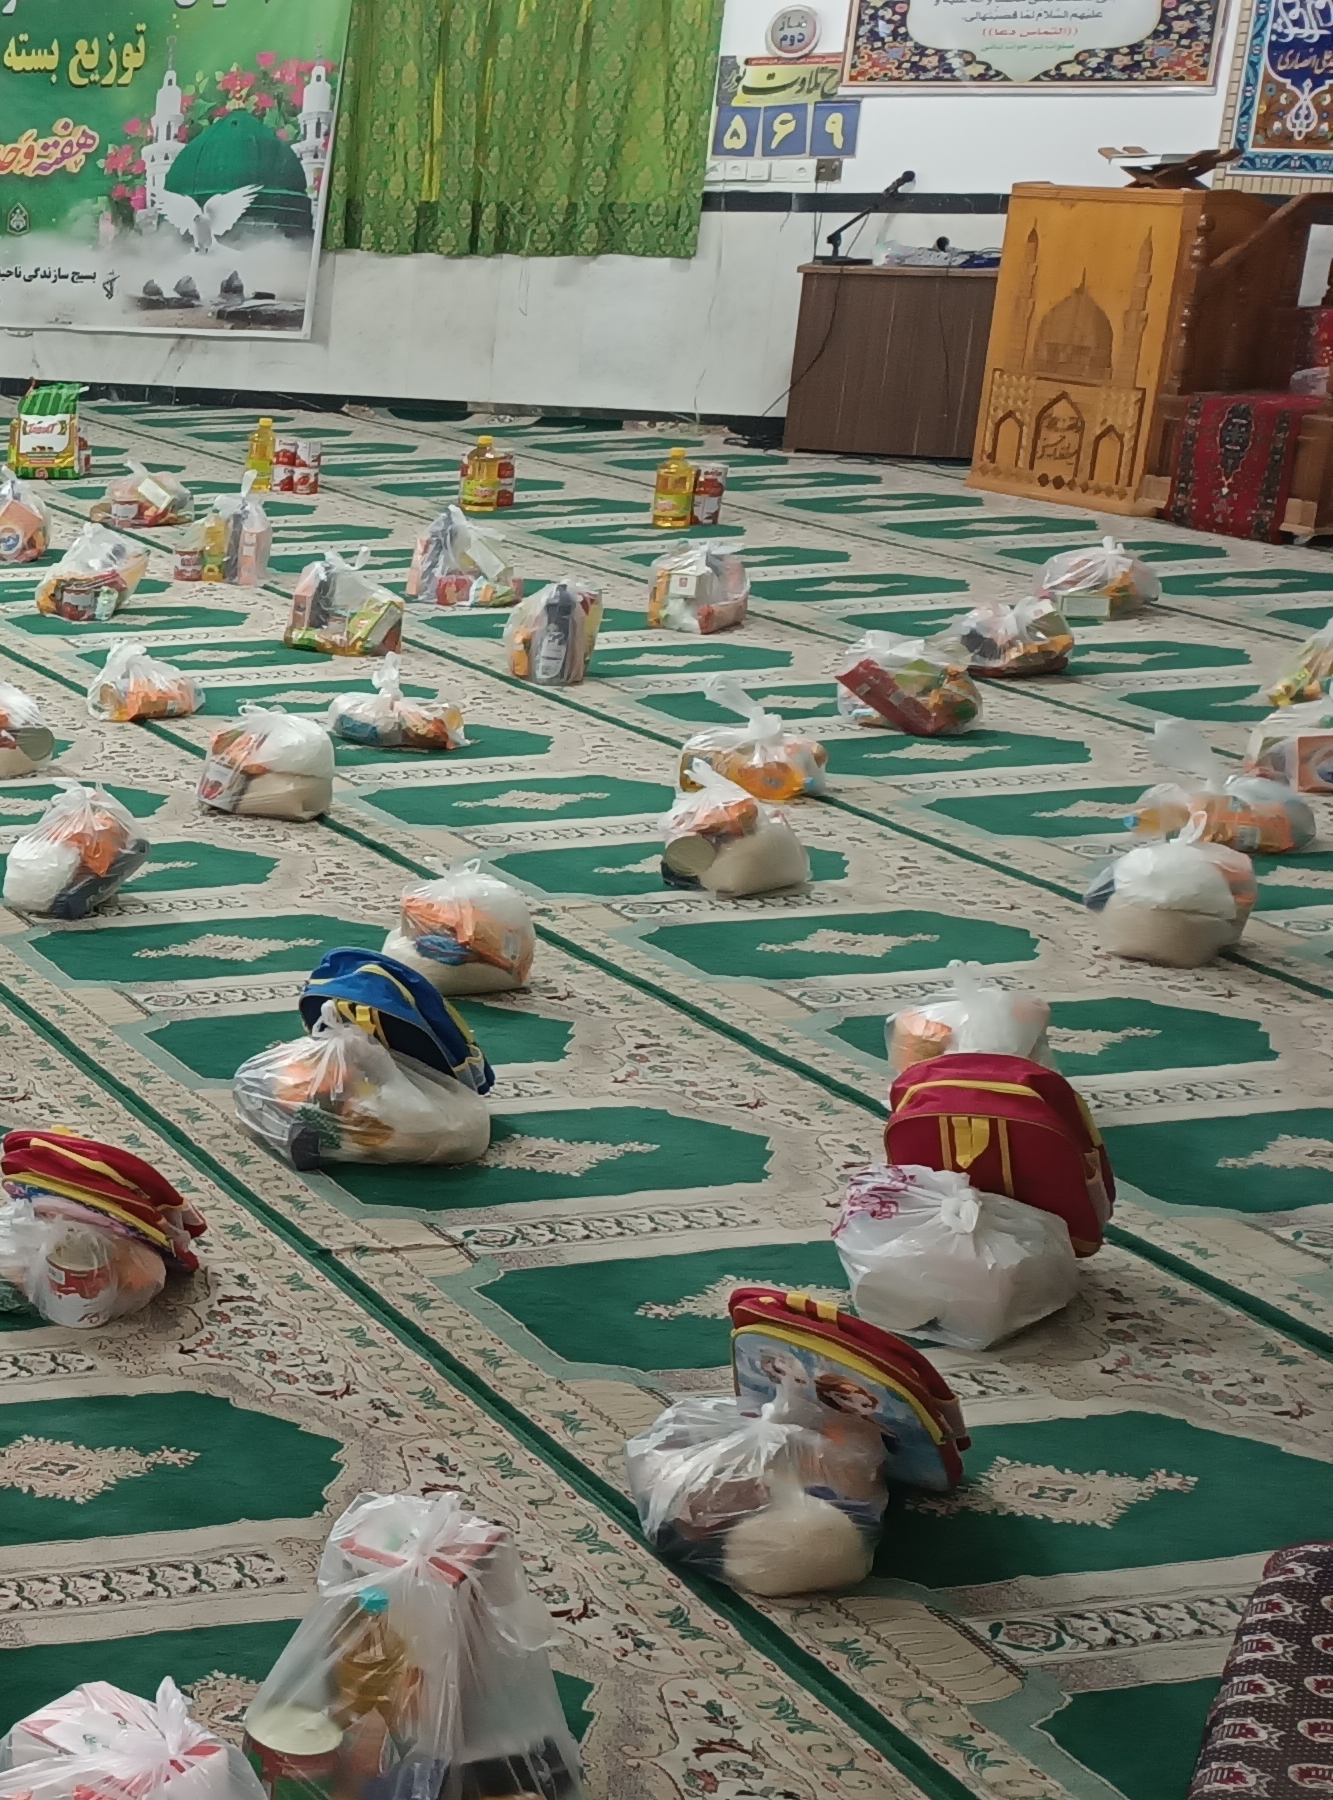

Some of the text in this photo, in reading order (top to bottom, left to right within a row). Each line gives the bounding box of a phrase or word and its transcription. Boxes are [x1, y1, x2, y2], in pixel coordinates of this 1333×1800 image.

[779, 32, 806, 46] دوم
[3, 33, 60, 84] بسته
[68, 22, 147, 87] توزیع
[742, 65, 823, 95] تلاوت
[32, 118, 99, 174] هفته
[22, 265, 70, 283] سازندگی
[70, 265, 97, 284] بسیج
